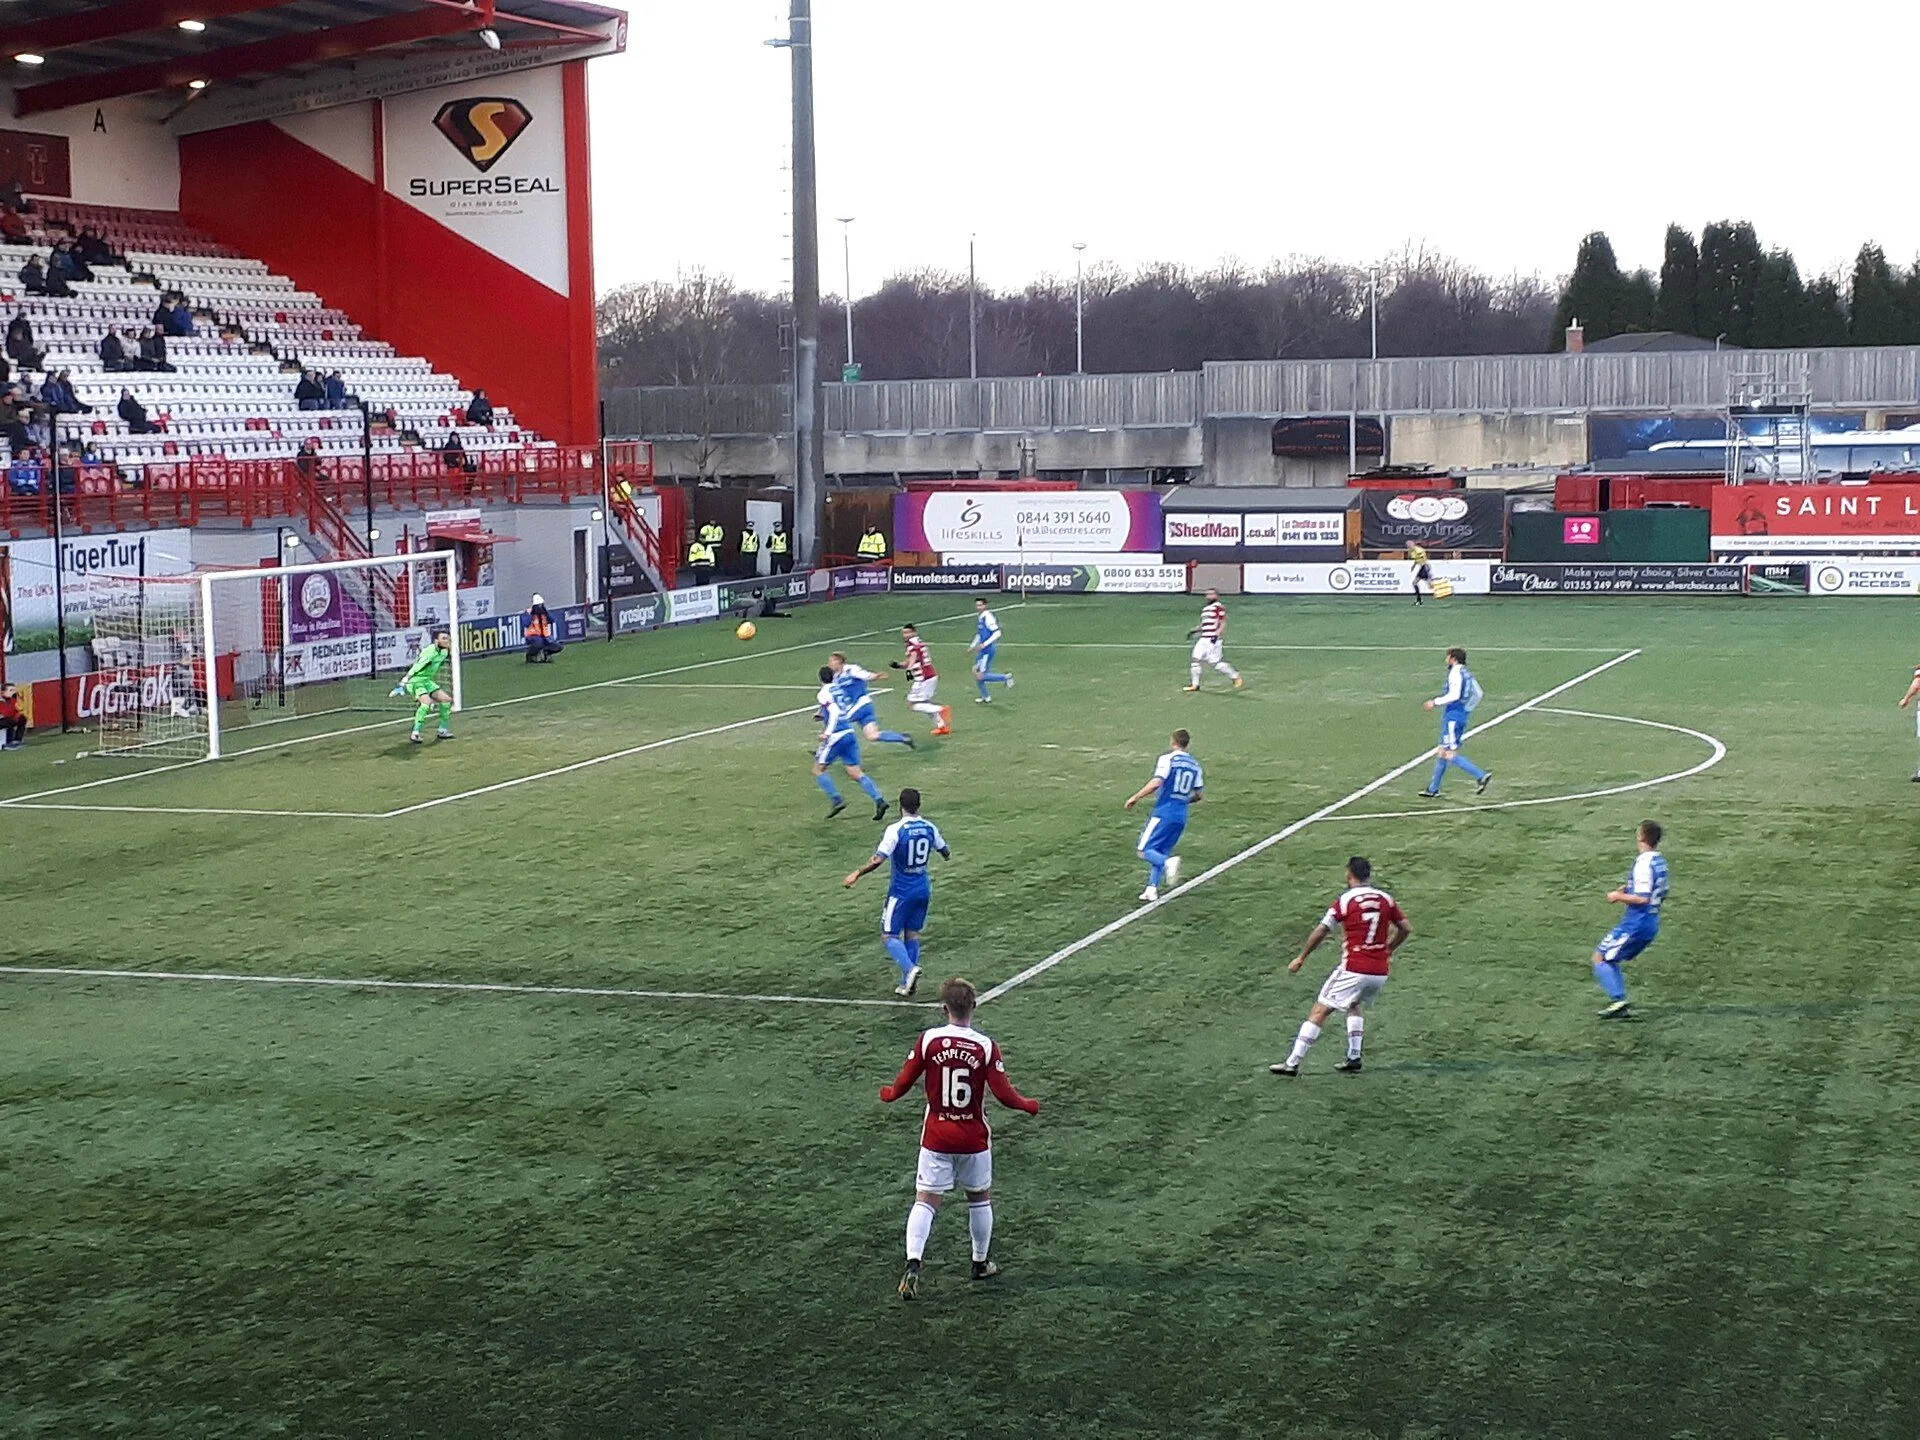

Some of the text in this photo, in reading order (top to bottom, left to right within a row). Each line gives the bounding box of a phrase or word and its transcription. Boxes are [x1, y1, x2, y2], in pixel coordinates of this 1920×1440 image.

[93, 107, 107, 134] A
[1776, 496, 1882, 516] SAINT
[1016, 511, 1111, 524] 0844 391 5640
[1175, 523, 1239, 539] ShedMan
[1246, 527, 1277, 539] .co.uk
[1381, 521, 1474, 539] nursery times
[893, 570, 998, 586] blameless.org.uk
[1103, 568, 1131, 578] 0800
[1158, 568, 1184, 578] 5515
[1706, 566, 1740, 578] Choice
[1849, 571, 1905, 579] ACTIVE
[1007, 572, 1072, 590] prosigns
[1849, 580, 1911, 588] ACCESS
[360, 635, 397, 652] FECING
[1174, 768, 1194, 794] 10
[907, 837, 929, 866] 19
[1361, 912, 1381, 944] 7
[932, 1048, 981, 1070] TEMPLETON
[941, 1066, 972, 1109] 16
